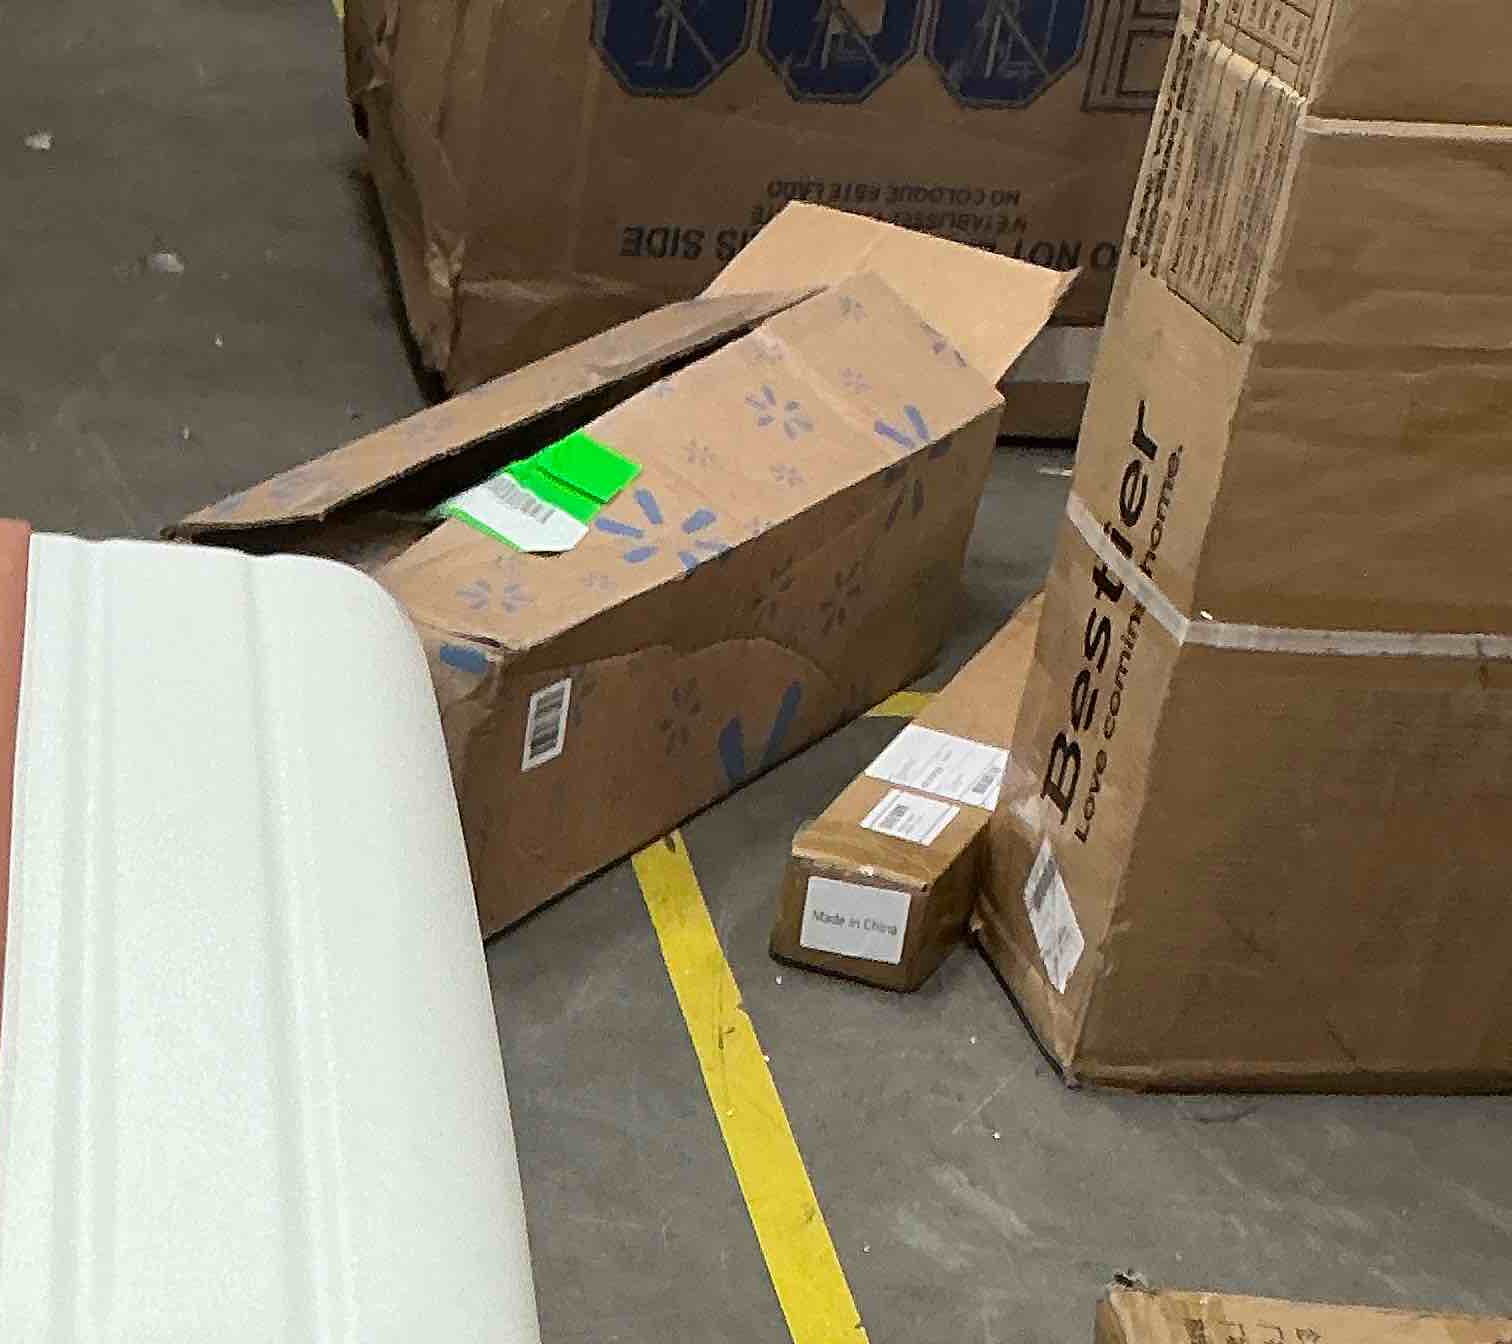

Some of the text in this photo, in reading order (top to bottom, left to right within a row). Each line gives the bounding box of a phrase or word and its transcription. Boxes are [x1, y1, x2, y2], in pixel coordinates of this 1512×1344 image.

[618, 225, 705, 261] SIDE
[1040, 399, 1160, 825] Bestier
[1074, 748, 1108, 843] Love
